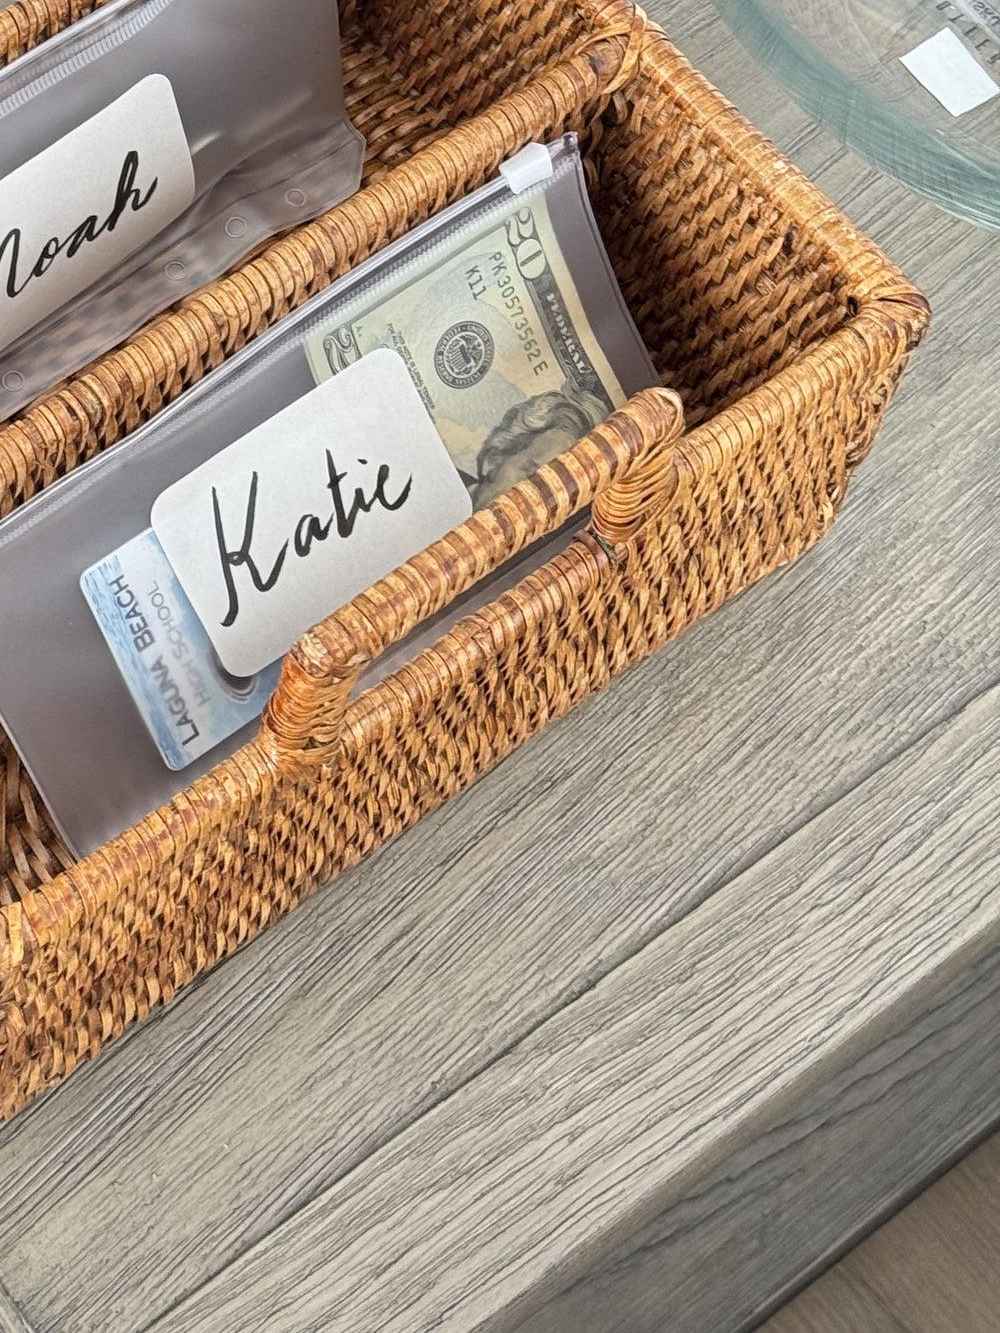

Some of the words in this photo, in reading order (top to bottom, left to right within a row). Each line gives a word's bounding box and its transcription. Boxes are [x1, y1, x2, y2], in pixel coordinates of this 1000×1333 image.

[465, 265, 487, 300] K11
[504, 206, 547, 281] 20
[212, 448, 413, 627] Katie
[109, 574, 155, 653] BEACH
[148, 580, 189, 661] SCHOOL
[149, 654, 200, 746] LAGUNA
